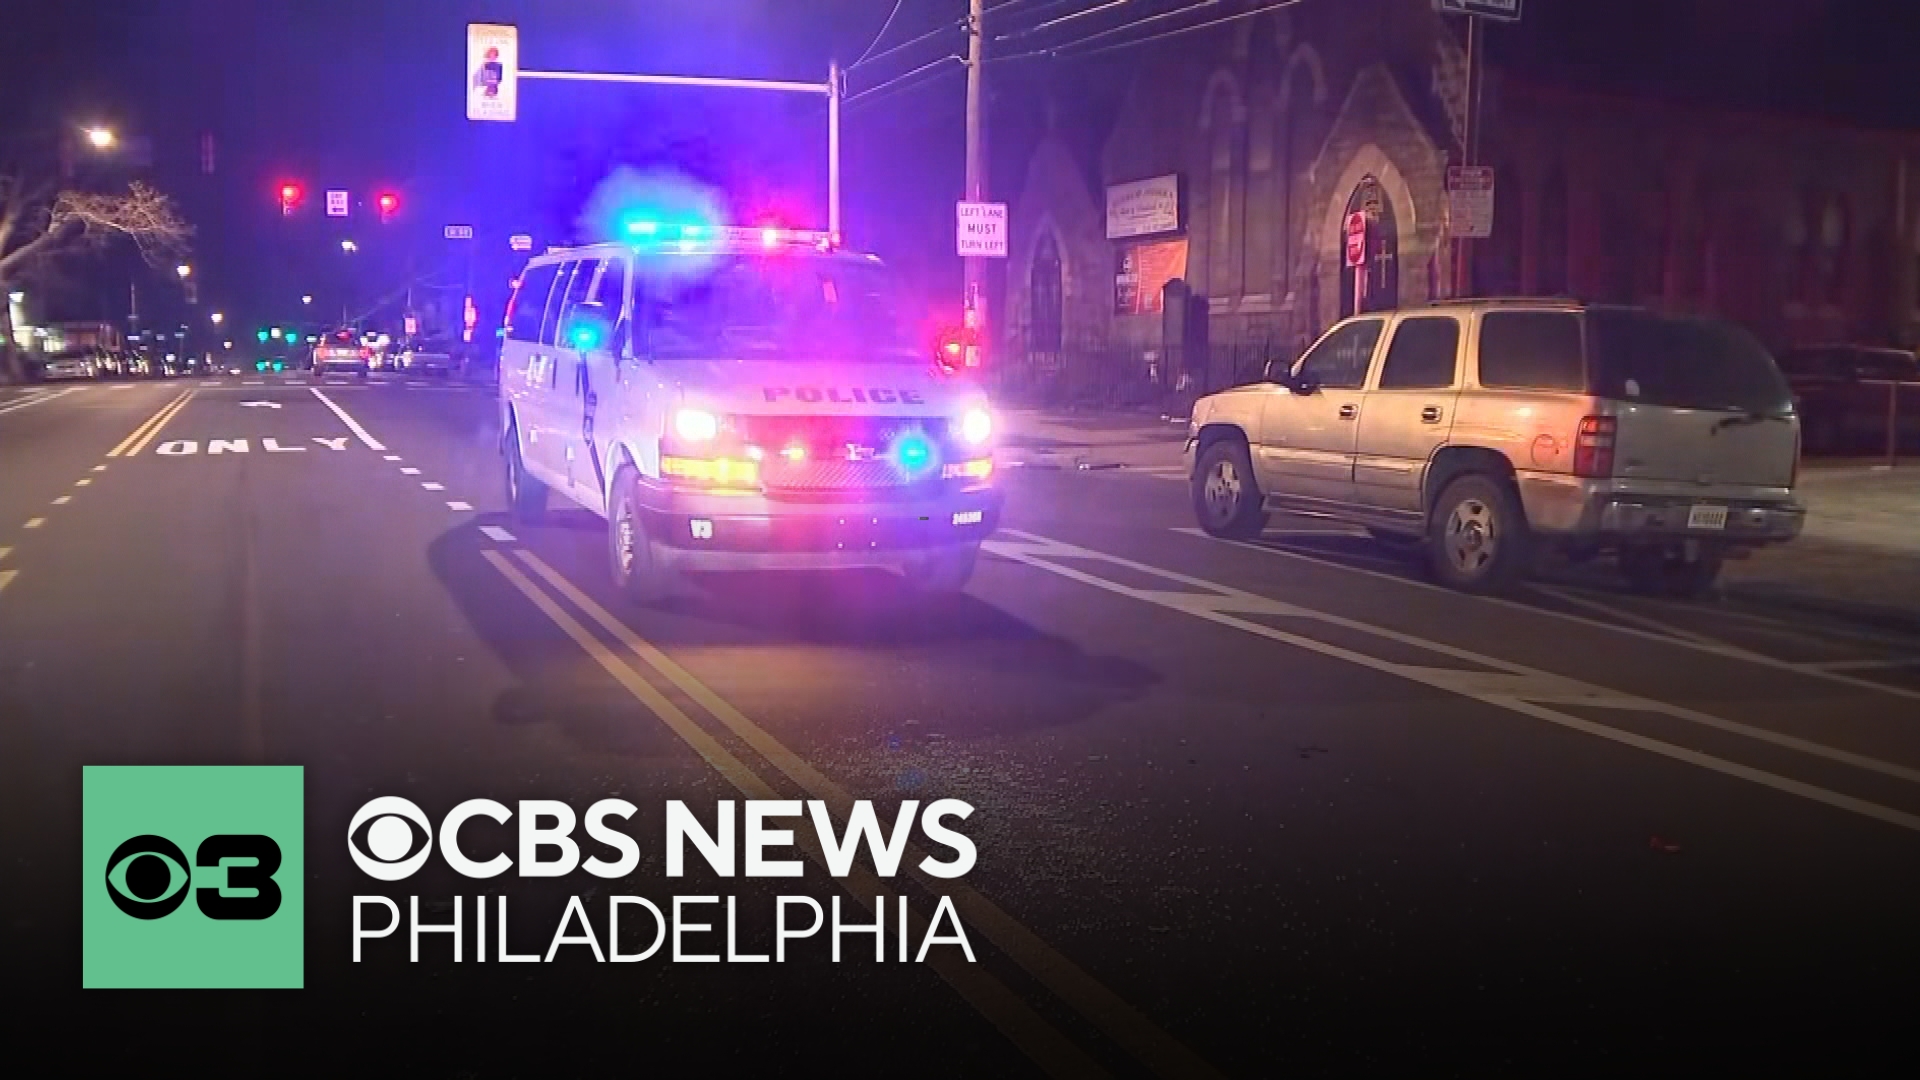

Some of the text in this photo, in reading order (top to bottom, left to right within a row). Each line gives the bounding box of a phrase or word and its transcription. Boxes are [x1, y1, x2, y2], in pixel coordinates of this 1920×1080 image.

[967, 223, 996, 235] MUST
[762, 387, 925, 405] POLICE
[155, 437, 349, 455] ONLY
